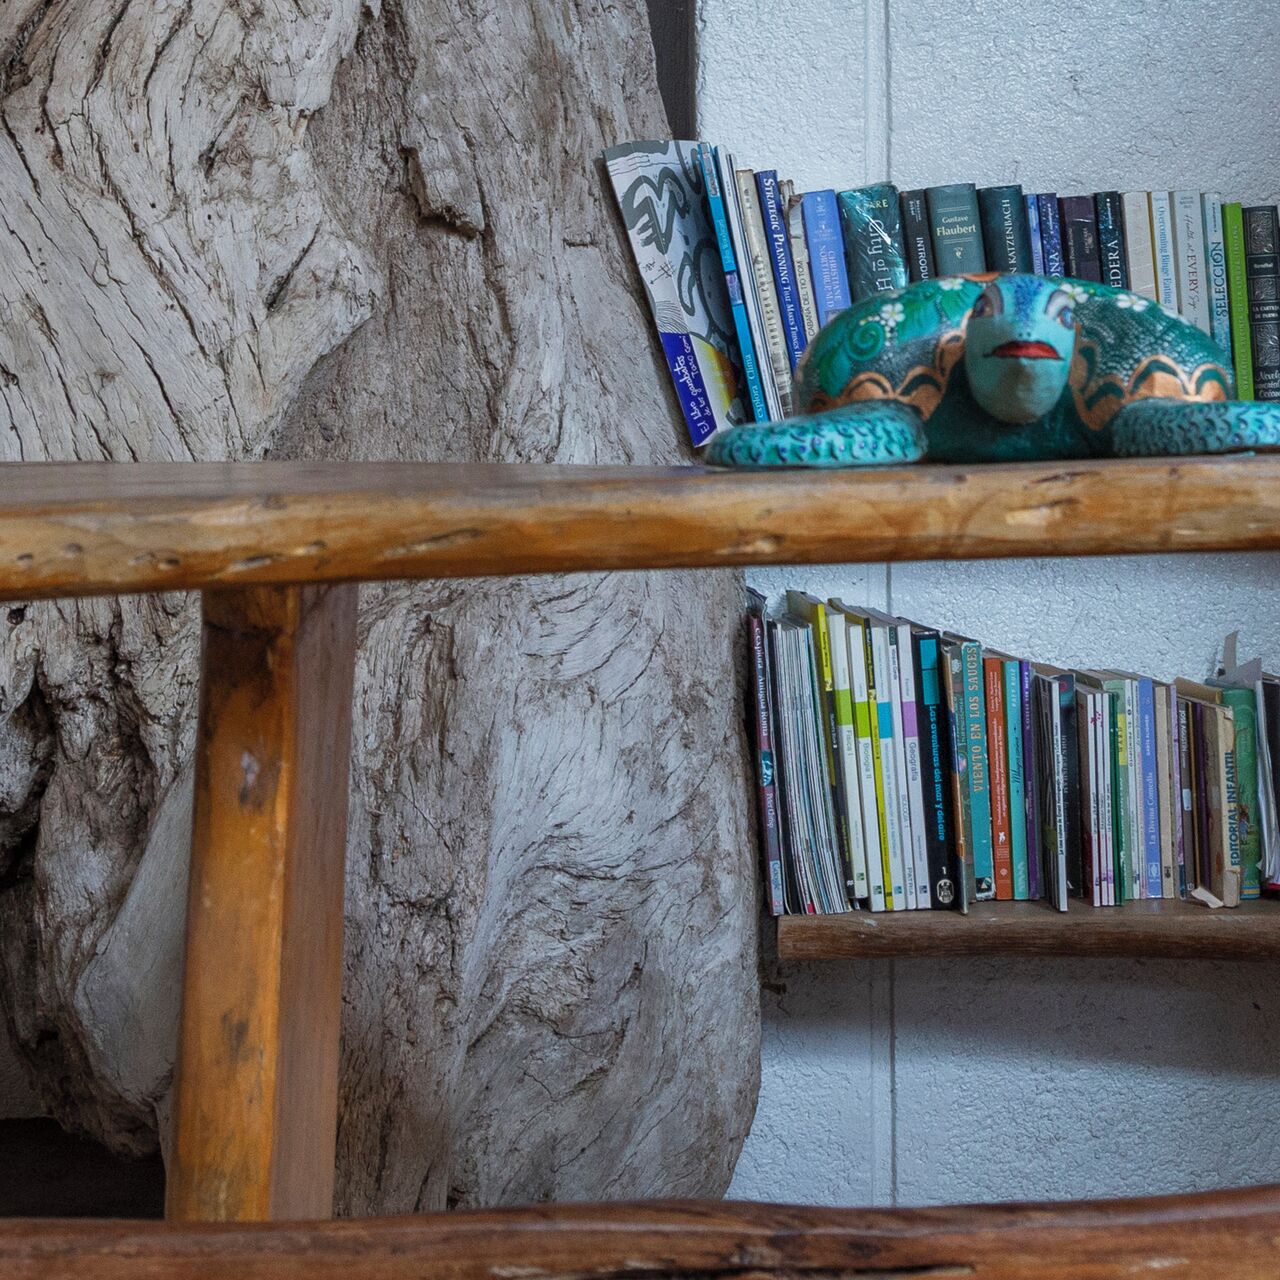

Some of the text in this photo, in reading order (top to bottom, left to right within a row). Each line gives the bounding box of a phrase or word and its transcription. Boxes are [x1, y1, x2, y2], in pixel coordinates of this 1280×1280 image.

[764, 178, 781, 232] STRATEGIC
[773, 234, 790, 284] PLANNING
[868, 220, 890, 255] City
[936, 224, 977, 236] Flaubert
[942, 216, 969, 225] Gustave
[1002, 199, 1018, 267] KATZENBACH
[797, 261, 806, 276] TOM
[1187, 254, 1200, 293] EVERY
[802, 292, 811, 306] DEL
[744, 353, 754, 379] Clima
[758, 675, 769, 736] Antigua Roma
[967, 646, 983, 792] VIENTO EN LOS SAUCES
[931, 723, 939, 767] aventuras
[1224, 751, 1239, 866] EDITORIAL INFANTIL
